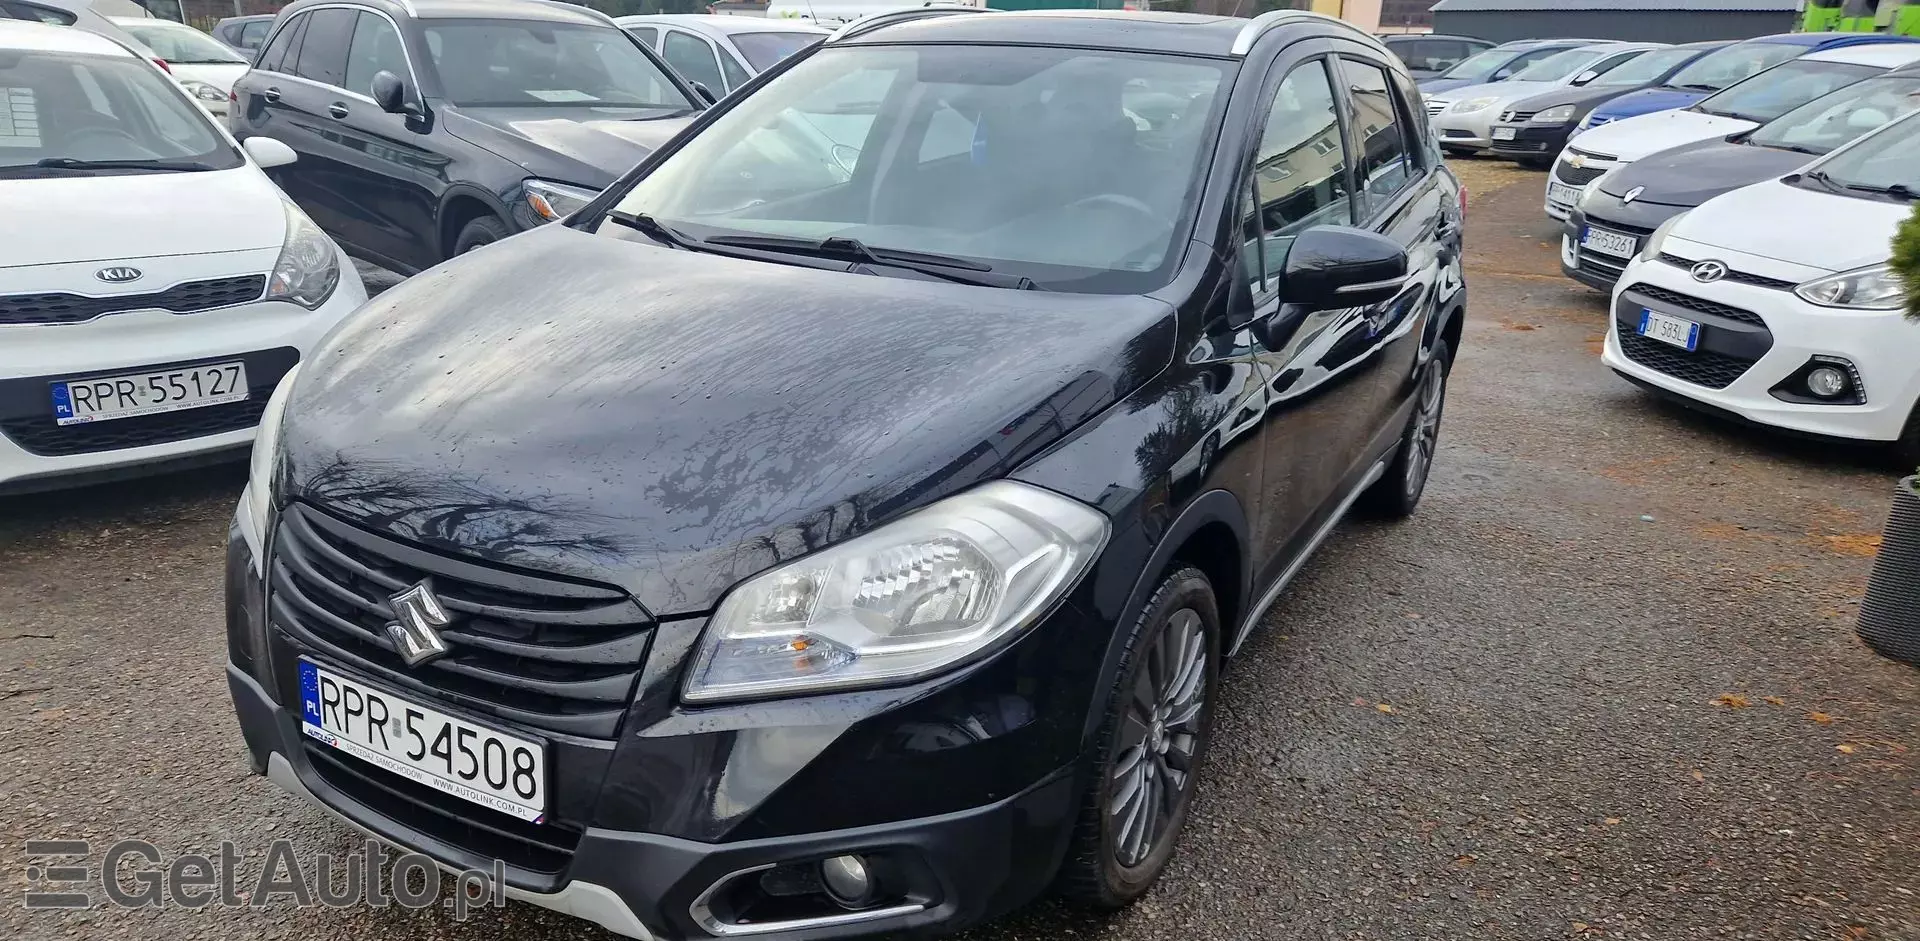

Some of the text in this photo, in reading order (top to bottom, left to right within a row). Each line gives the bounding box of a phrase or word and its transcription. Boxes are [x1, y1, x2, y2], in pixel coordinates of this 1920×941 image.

[1601, 233, 1633, 254] 53261
[102, 268, 138, 280] KIA
[71, 366, 240, 413] RPR 55127
[57, 405, 71, 413] PL
[306, 699, 319, 717] PL
[320, 675, 536, 800] RPR 54508
[433, 778, 527, 816] WWW.AUTOLINK.COM.PL
